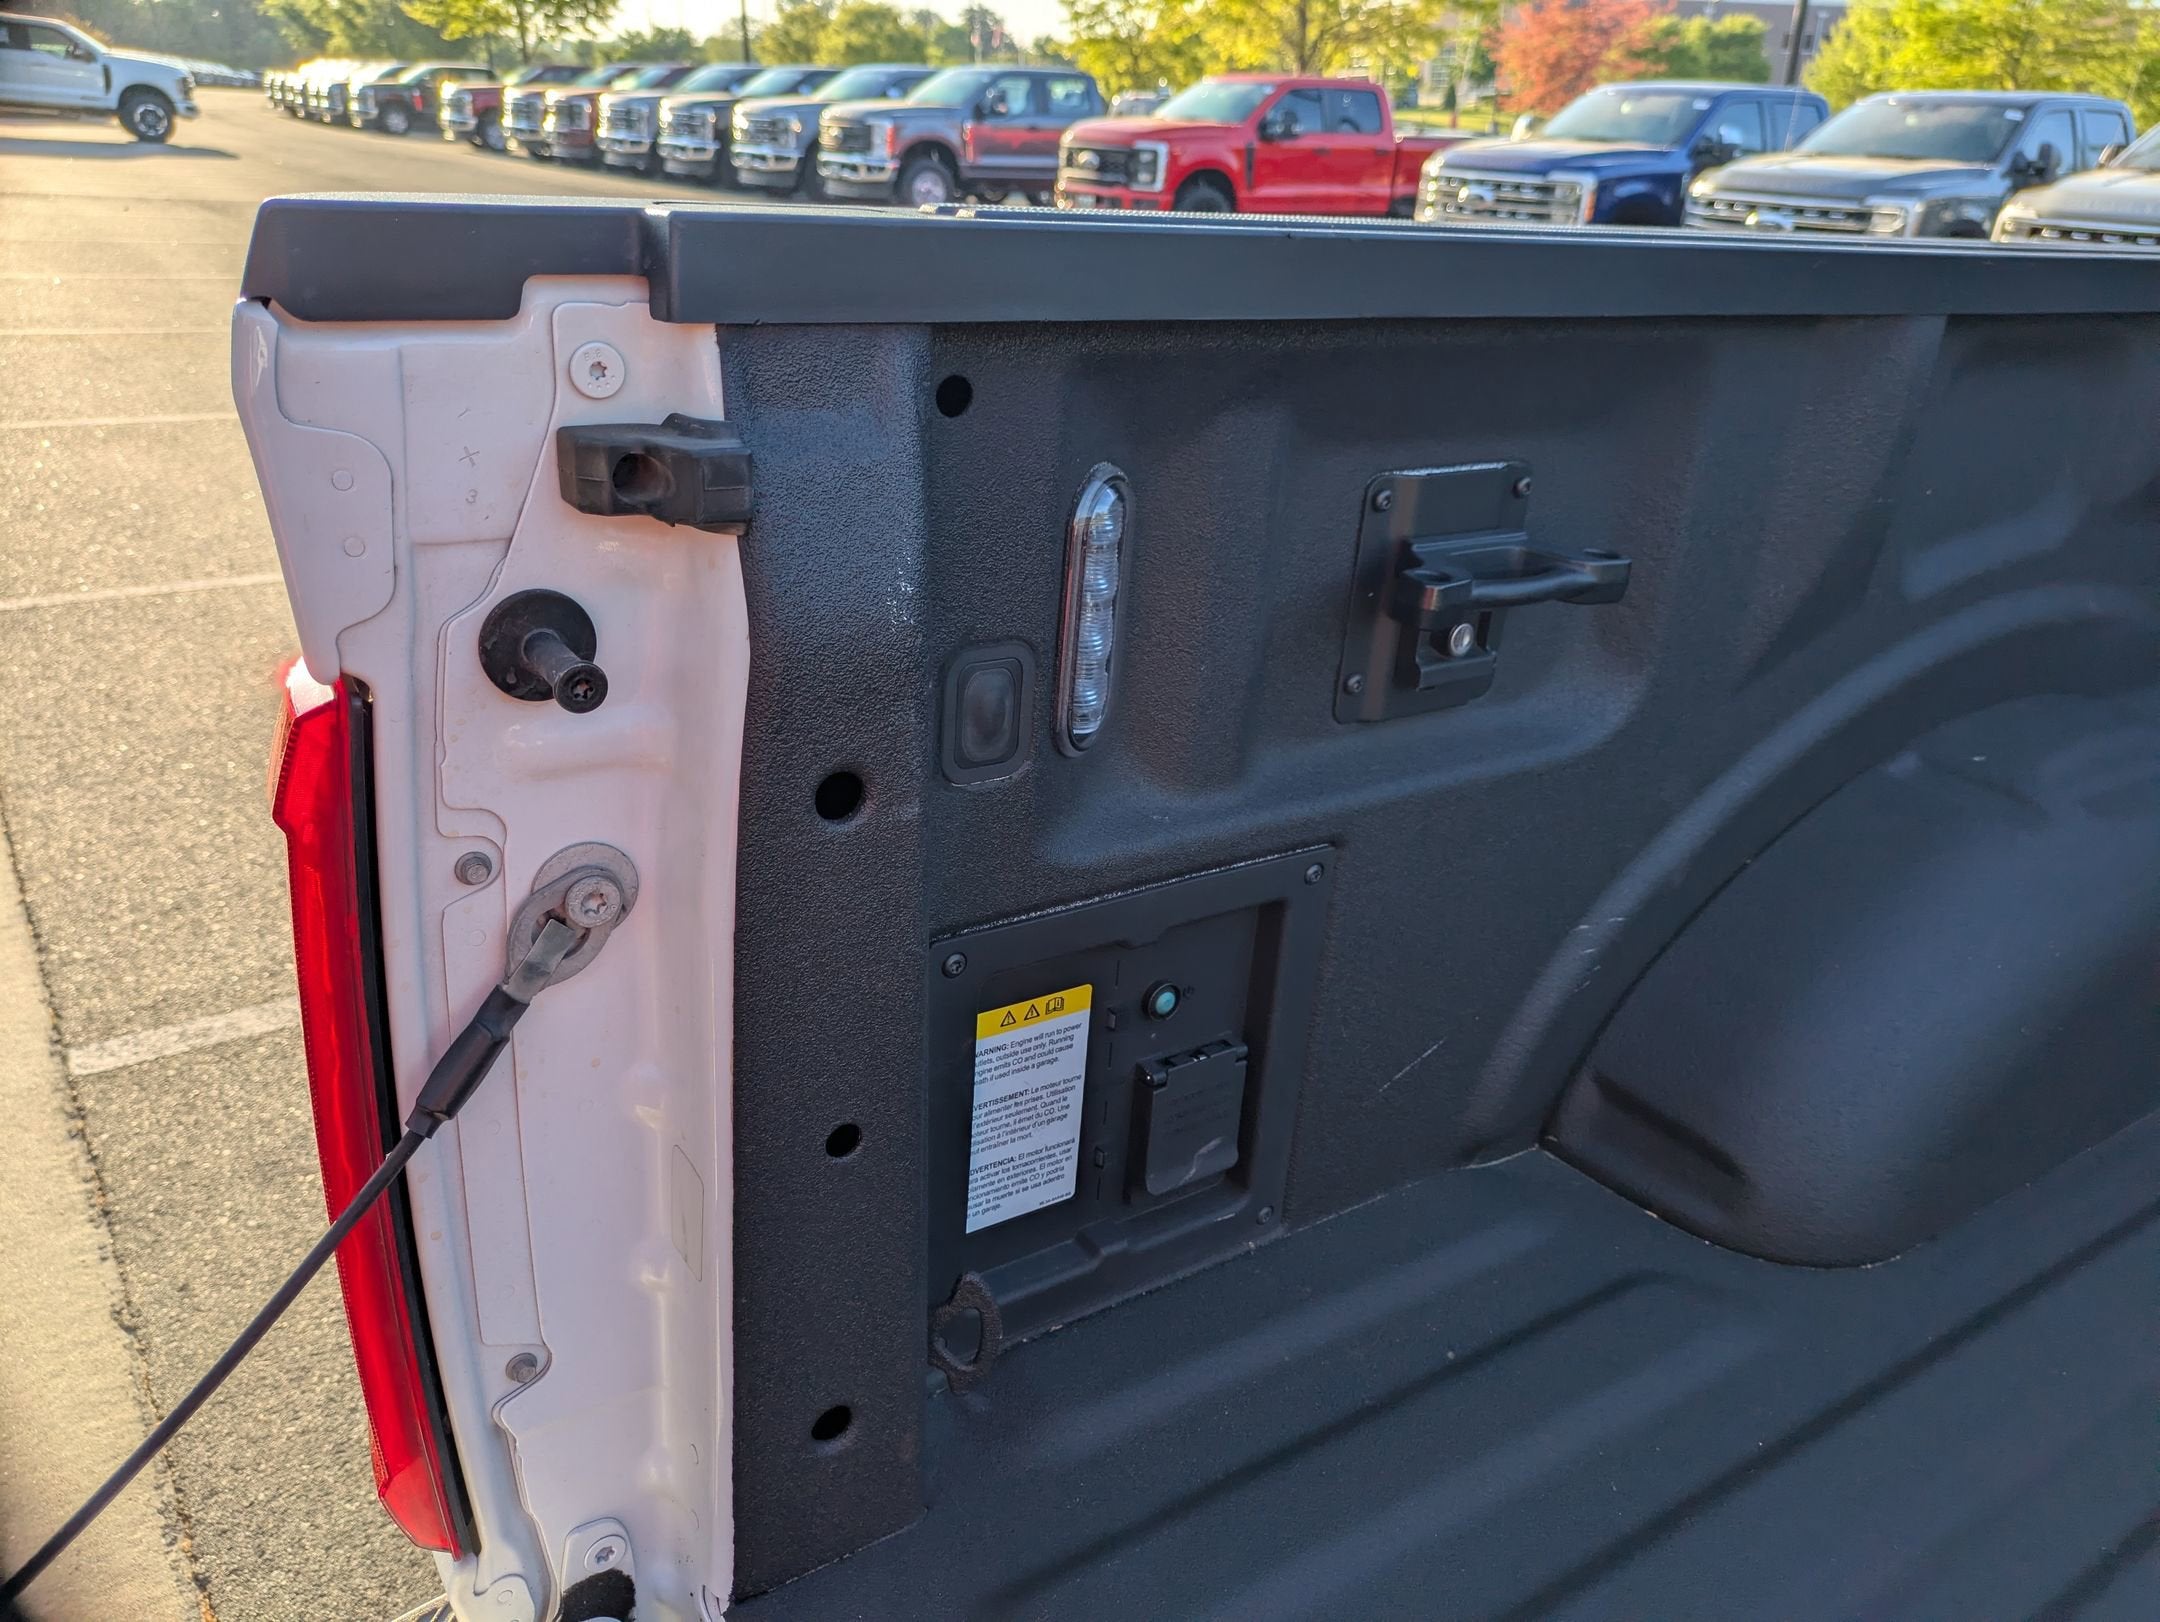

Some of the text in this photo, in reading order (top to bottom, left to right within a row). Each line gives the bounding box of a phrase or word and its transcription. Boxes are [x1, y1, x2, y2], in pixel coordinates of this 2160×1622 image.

[976, 1058, 995, 1067] utlets,
[996, 1050, 1019, 1062] outside
[1020, 1047, 1032, 1055] use
[1048, 1034, 1074, 1047] Running
[1010, 1037, 1033, 1049] Engine
[1034, 1033, 1044, 1041] will
[1063, 1023, 1082, 1034] power
[975, 1043, 1073, 1077] ngine emits CO and could cause
[975, 1077, 988, 1085] eath
[995, 1070, 1010, 1080] used
[1011, 1065, 1030, 1075] inside
[974, 1089, 1030, 1111] VERTISSEMENT:
[1040, 1080, 1062, 1091] moteur
[984, 1104, 1013, 1117] alimenter
[1046, 1085, 1076, 1098] Utilisation
[1040, 1097, 1061, 1109] Quand
[972, 1128, 989, 1138] oteur
[1058, 1104, 1070, 1112] Une
[970, 1180, 995, 1192] olamente
[1039, 1162, 1045, 1170] El
[1047, 1158, 1064, 1168] motor
[971, 1156, 1016, 1176] DVERTENCIA:
[1026, 1148, 1044, 1158] motor
[980, 1170, 1000, 1181] activar
[1059, 1147, 1072, 1156] usar
[970, 1184, 1010, 1200] ncionamiento
[1029, 1173, 1040, 1181] CO
